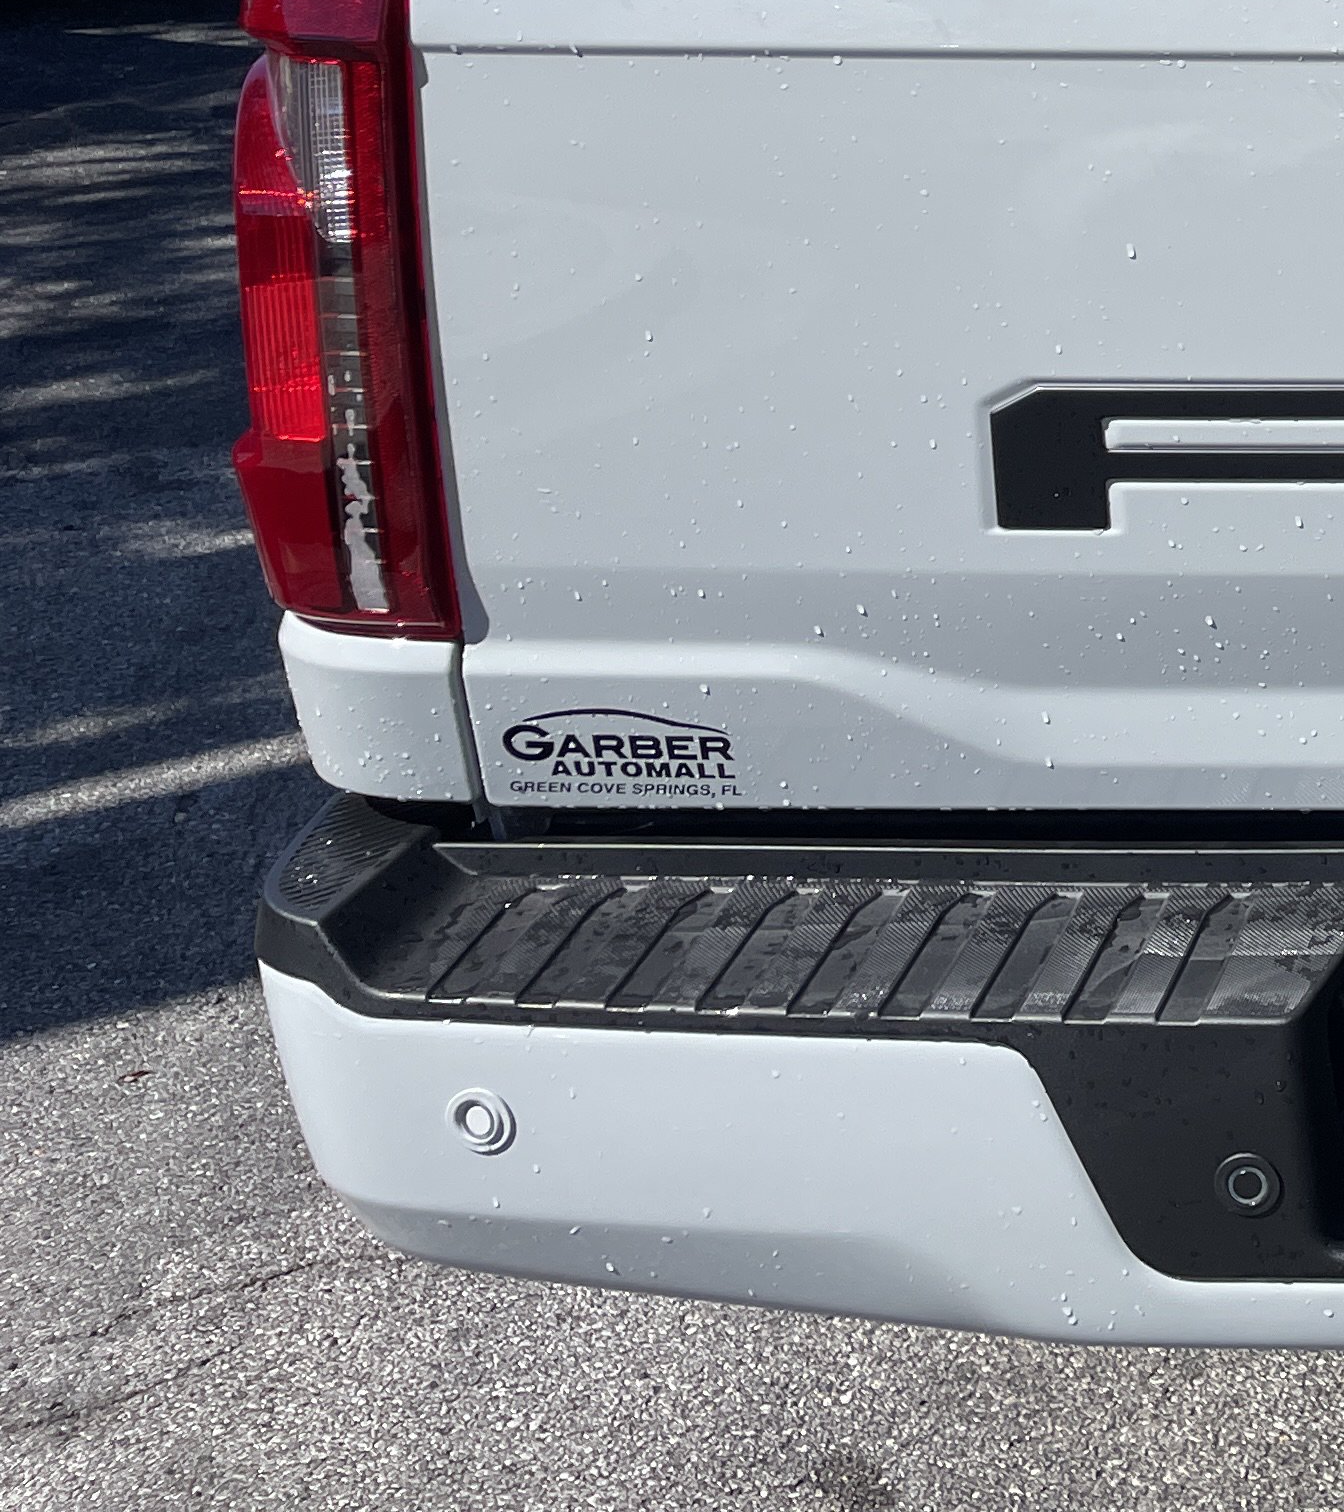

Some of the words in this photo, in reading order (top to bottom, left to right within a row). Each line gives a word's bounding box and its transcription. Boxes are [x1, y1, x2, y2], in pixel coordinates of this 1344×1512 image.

[502, 723, 736, 762] GARBER
[551, 760, 737, 779] AUTOMALL
[509, 780, 573, 794] GREEN
[577, 782, 627, 795] COVE
[632, 783, 717, 799] SPRINGS,
[721, 784, 743, 797] FL
